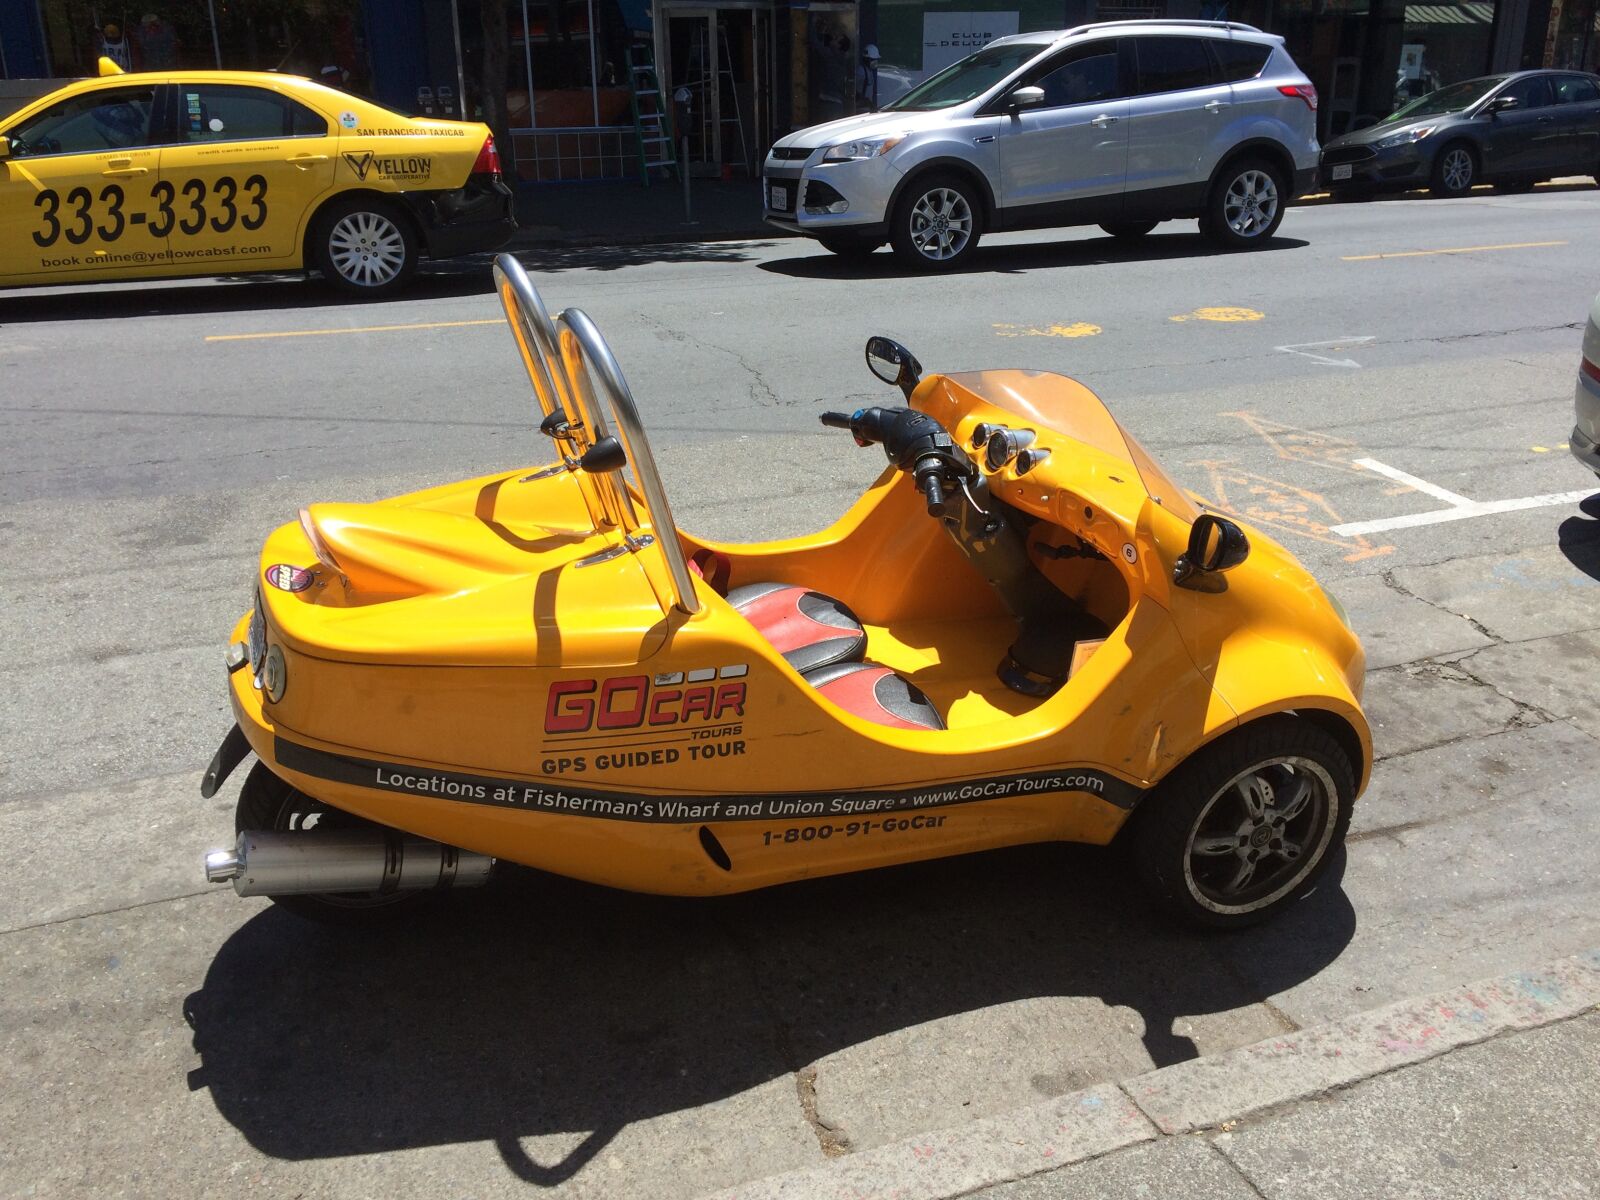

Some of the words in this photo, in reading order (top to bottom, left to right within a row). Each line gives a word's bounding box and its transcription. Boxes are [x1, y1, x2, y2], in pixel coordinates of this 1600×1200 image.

[356, 128, 376, 137] SAN
[378, 128, 426, 137] FRANCISCO
[429, 128, 465, 137] TAXICAB
[373, 158, 432, 175] YELLOW
[32, 174, 268, 248] 333-3333
[41, 255, 80, 267] book
[85, 245, 272, 265] online@yellowcabsf.com
[279, 565, 292, 591] SPEED
[690, 725, 743, 741] TOURS
[541, 756, 588, 775] GPS
[595, 748, 680, 770] GUIDED
[687, 740, 747, 761] TOUR
[375, 767, 487, 799] Locations
[492, 786, 516, 803] at
[522, 788, 654, 818] Fisherman's
[657, 801, 720, 818] Wharf
[724, 801, 763, 817] and
[768, 799, 826, 816] Union
[829, 797, 895, 814] Square
[912, 774, 1105, 807] www.GoCarTours.com
[762, 814, 948, 847] 1-800-91-GoCar
